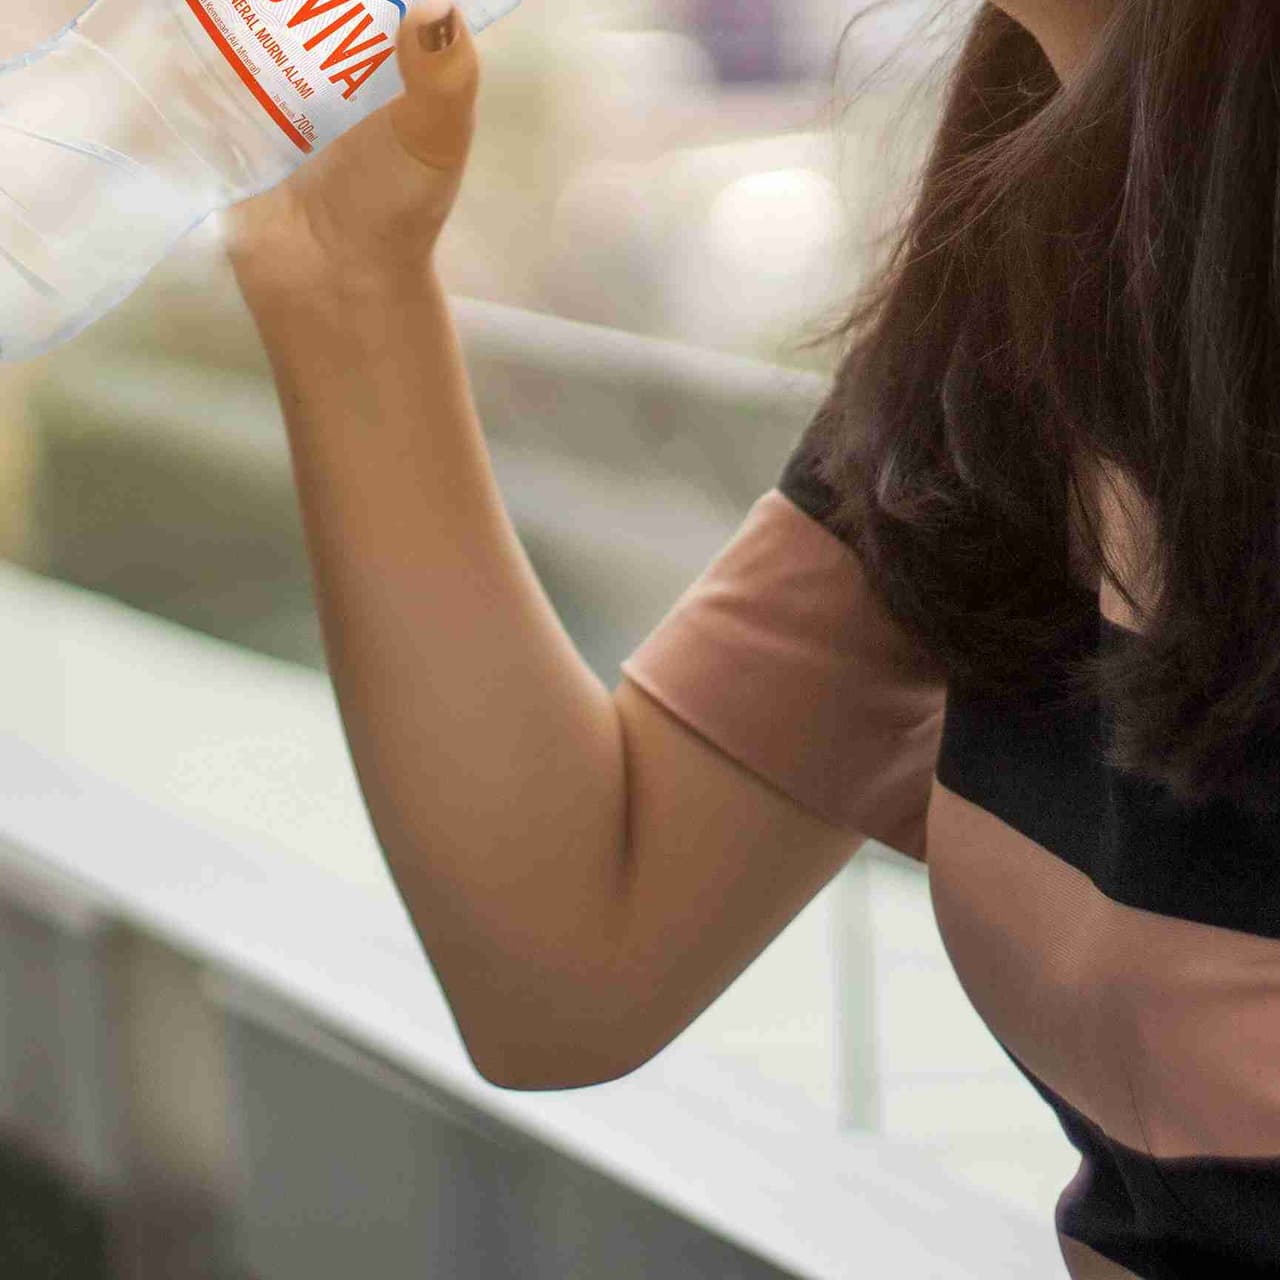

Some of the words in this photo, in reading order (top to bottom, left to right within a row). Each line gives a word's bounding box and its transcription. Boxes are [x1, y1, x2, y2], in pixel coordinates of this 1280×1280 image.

[205, 1, 230, 35] Kemasan
[236, 45, 261, 76] Mineral)
[255, 27, 289, 67] MURNI
[282, 65, 315, 100] ALAMI
[293, 113, 319, 143] 700ml
